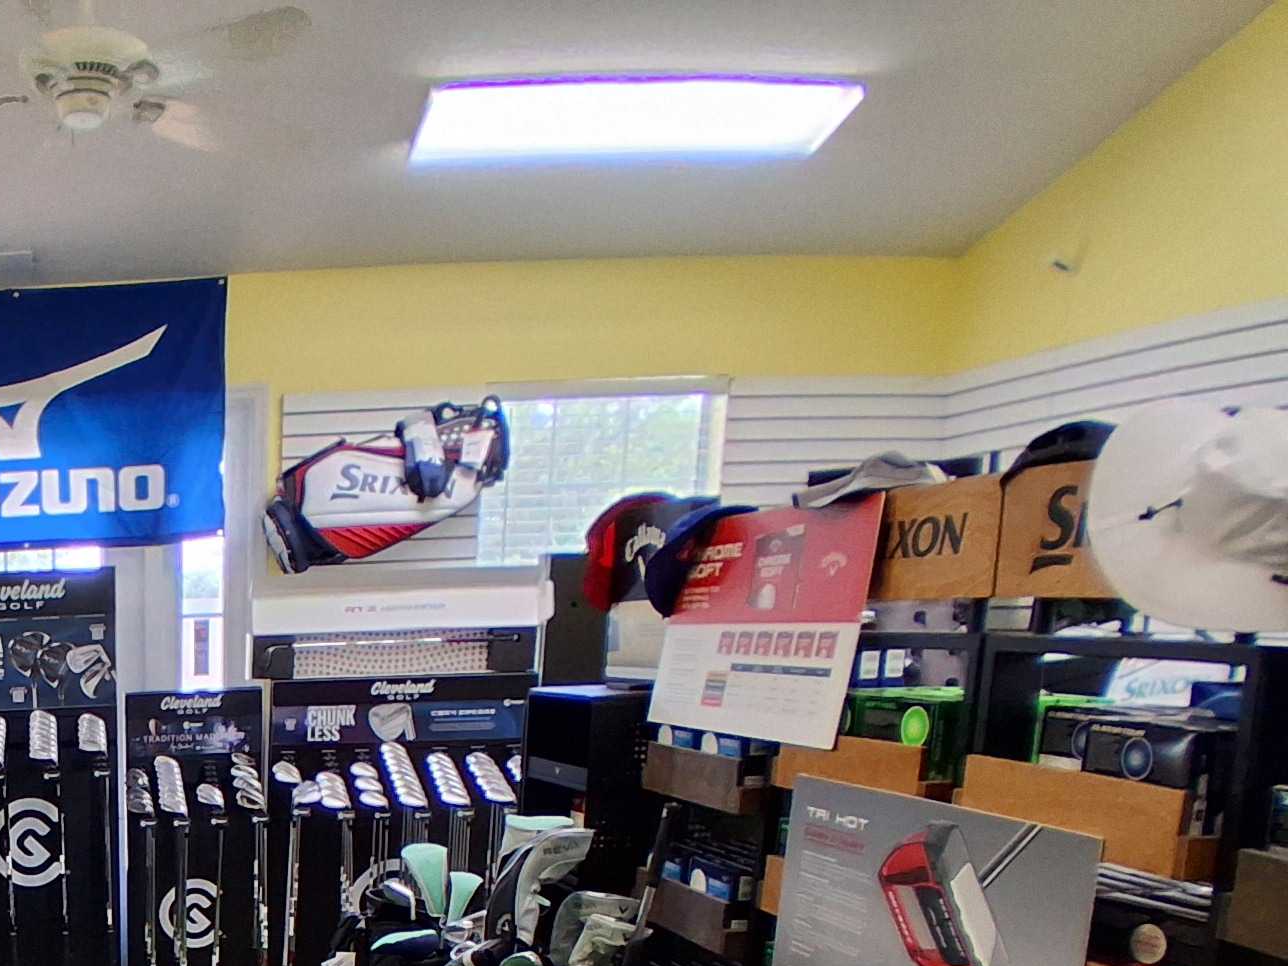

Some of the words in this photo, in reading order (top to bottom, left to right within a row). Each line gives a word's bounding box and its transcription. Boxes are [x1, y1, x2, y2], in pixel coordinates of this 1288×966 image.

[370, 679, 437, 696] Cleveland
[160, 693, 224, 711] Cleveland
[306, 704, 357, 727] CHUNK
[306, 725, 342, 742] LESS
[806, 805, 830, 822] TRI
[834, 812, 870, 831] HOT
